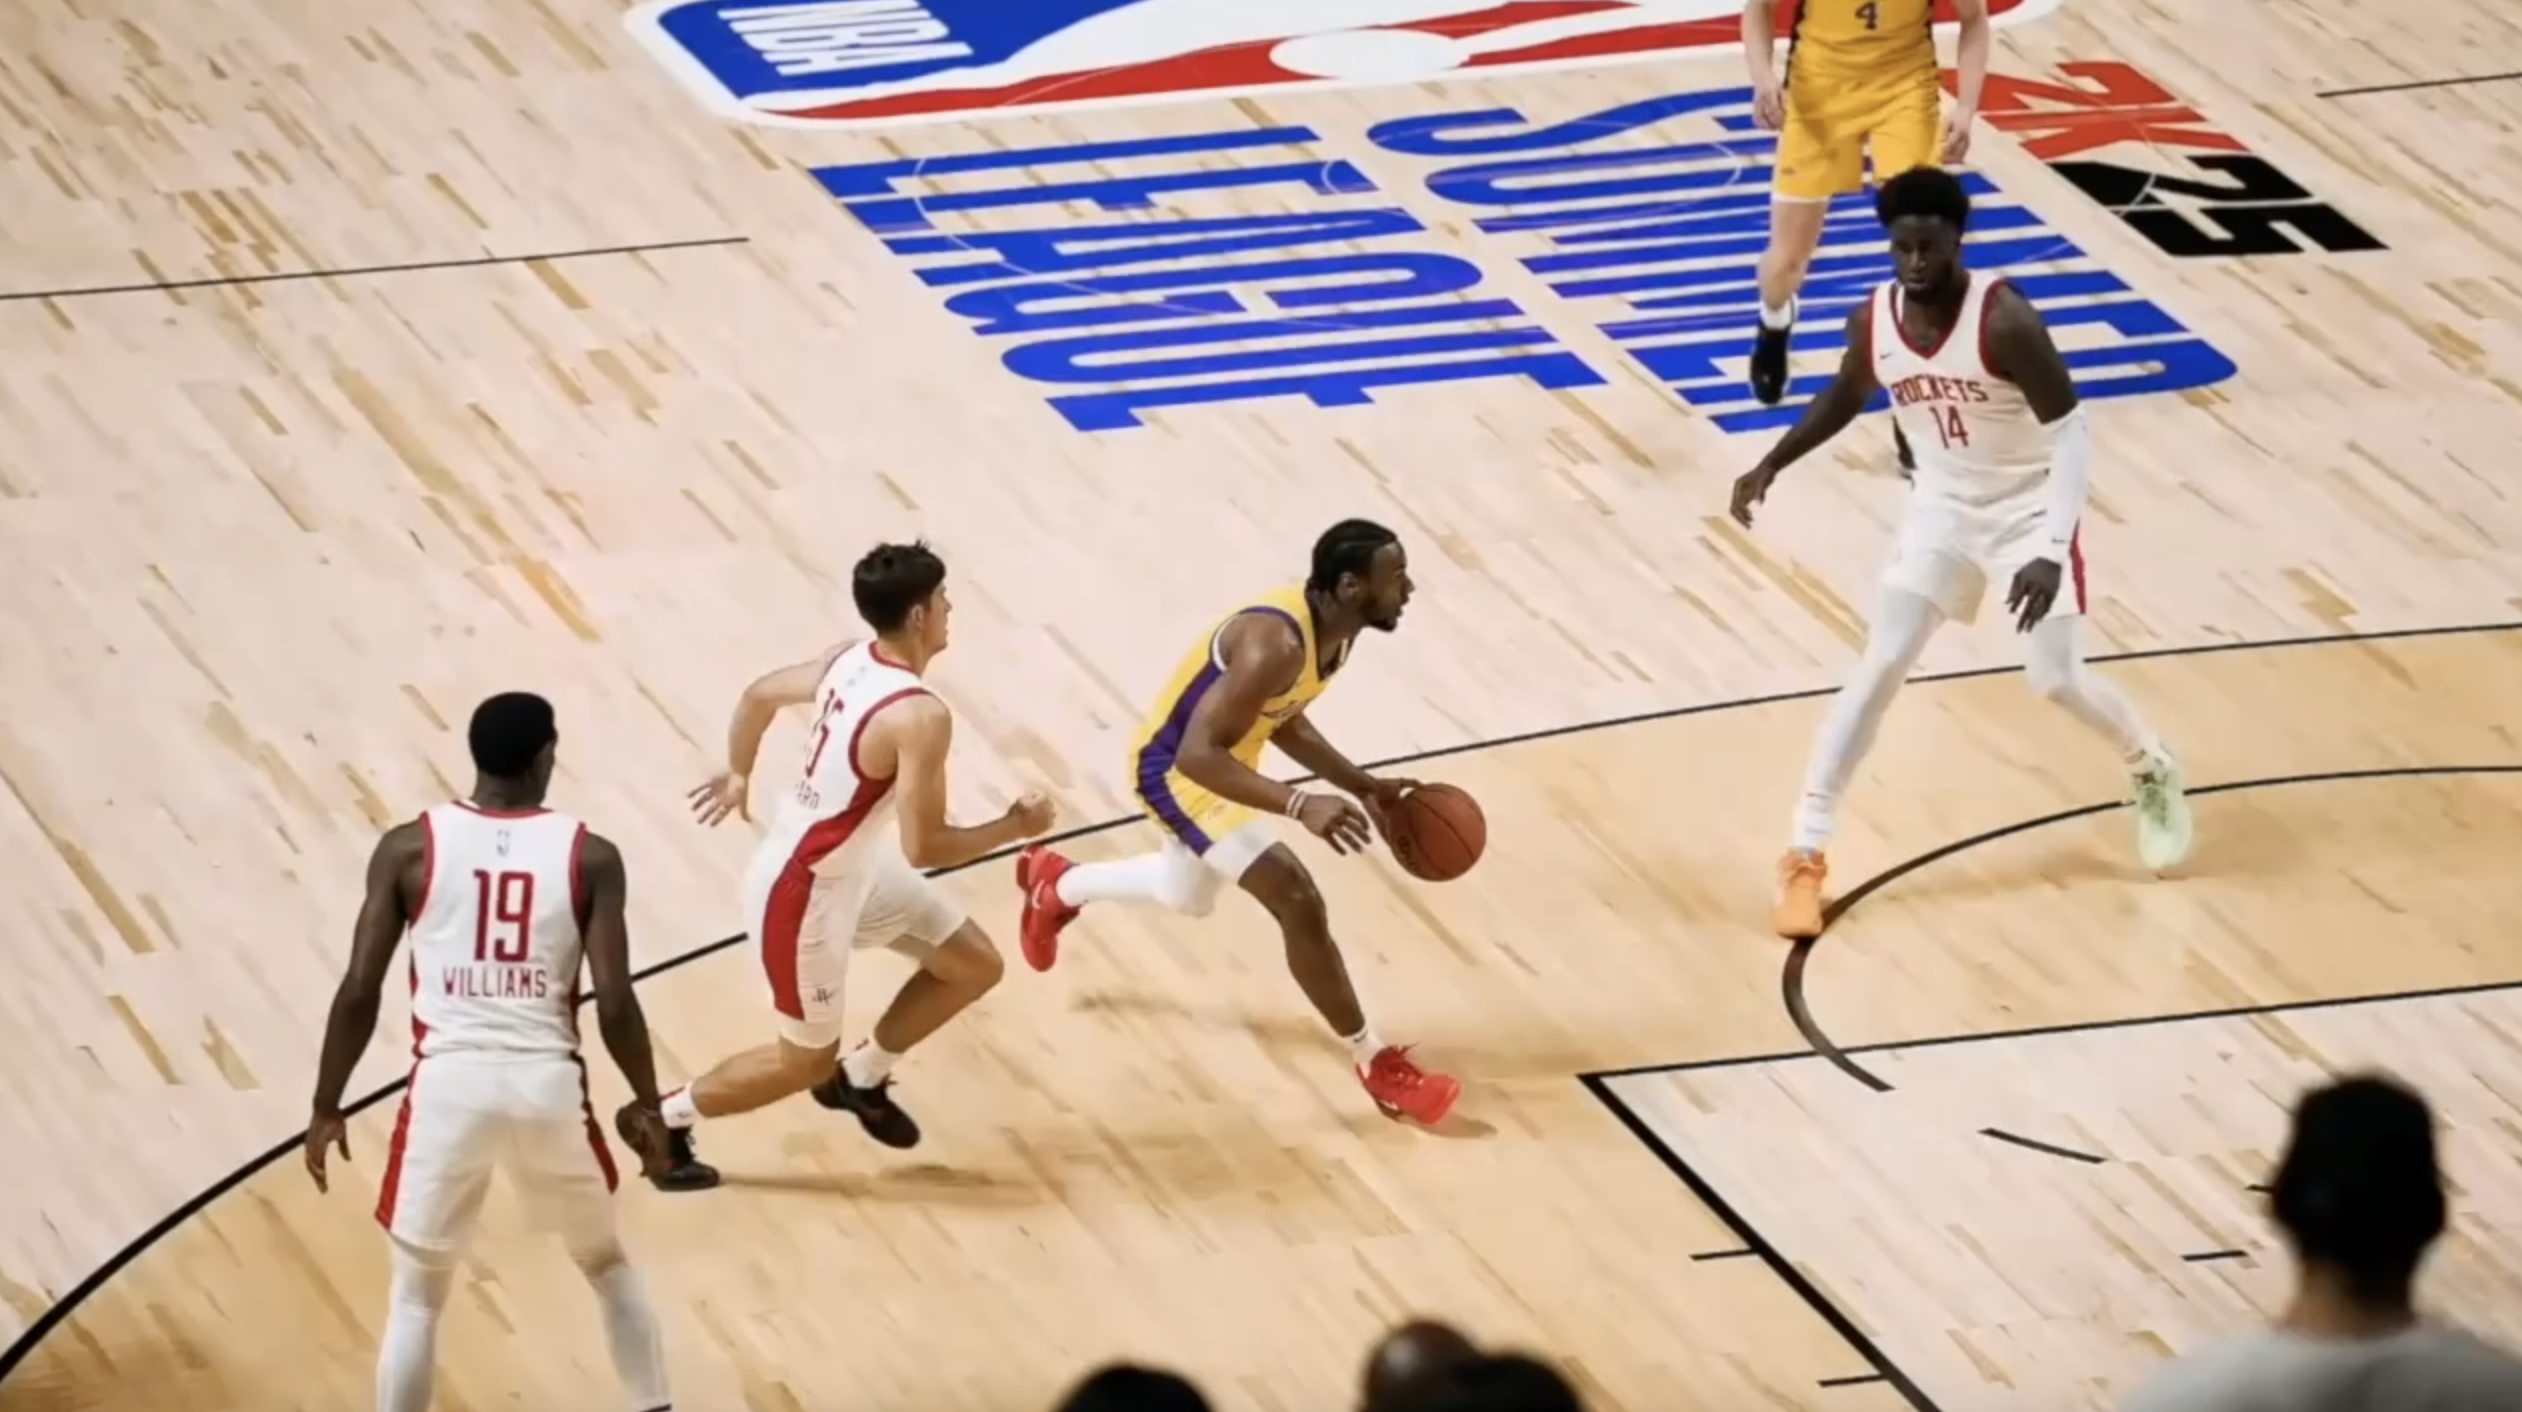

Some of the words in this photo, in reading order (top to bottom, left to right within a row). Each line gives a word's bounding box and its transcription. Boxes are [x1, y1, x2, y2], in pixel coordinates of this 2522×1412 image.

[716, 0, 974, 76] NBA
[1854, 1, 1877, 31] 4
[805, 125, 1609, 432] LEAGUE
[1366, 86, 2237, 434] SUMMER
[1890, 373, 1990, 408] ROCKETS
[1928, 405, 1970, 450] 14
[472, 868, 535, 963] 19
[442, 966, 548, 999] WILLIAMS
